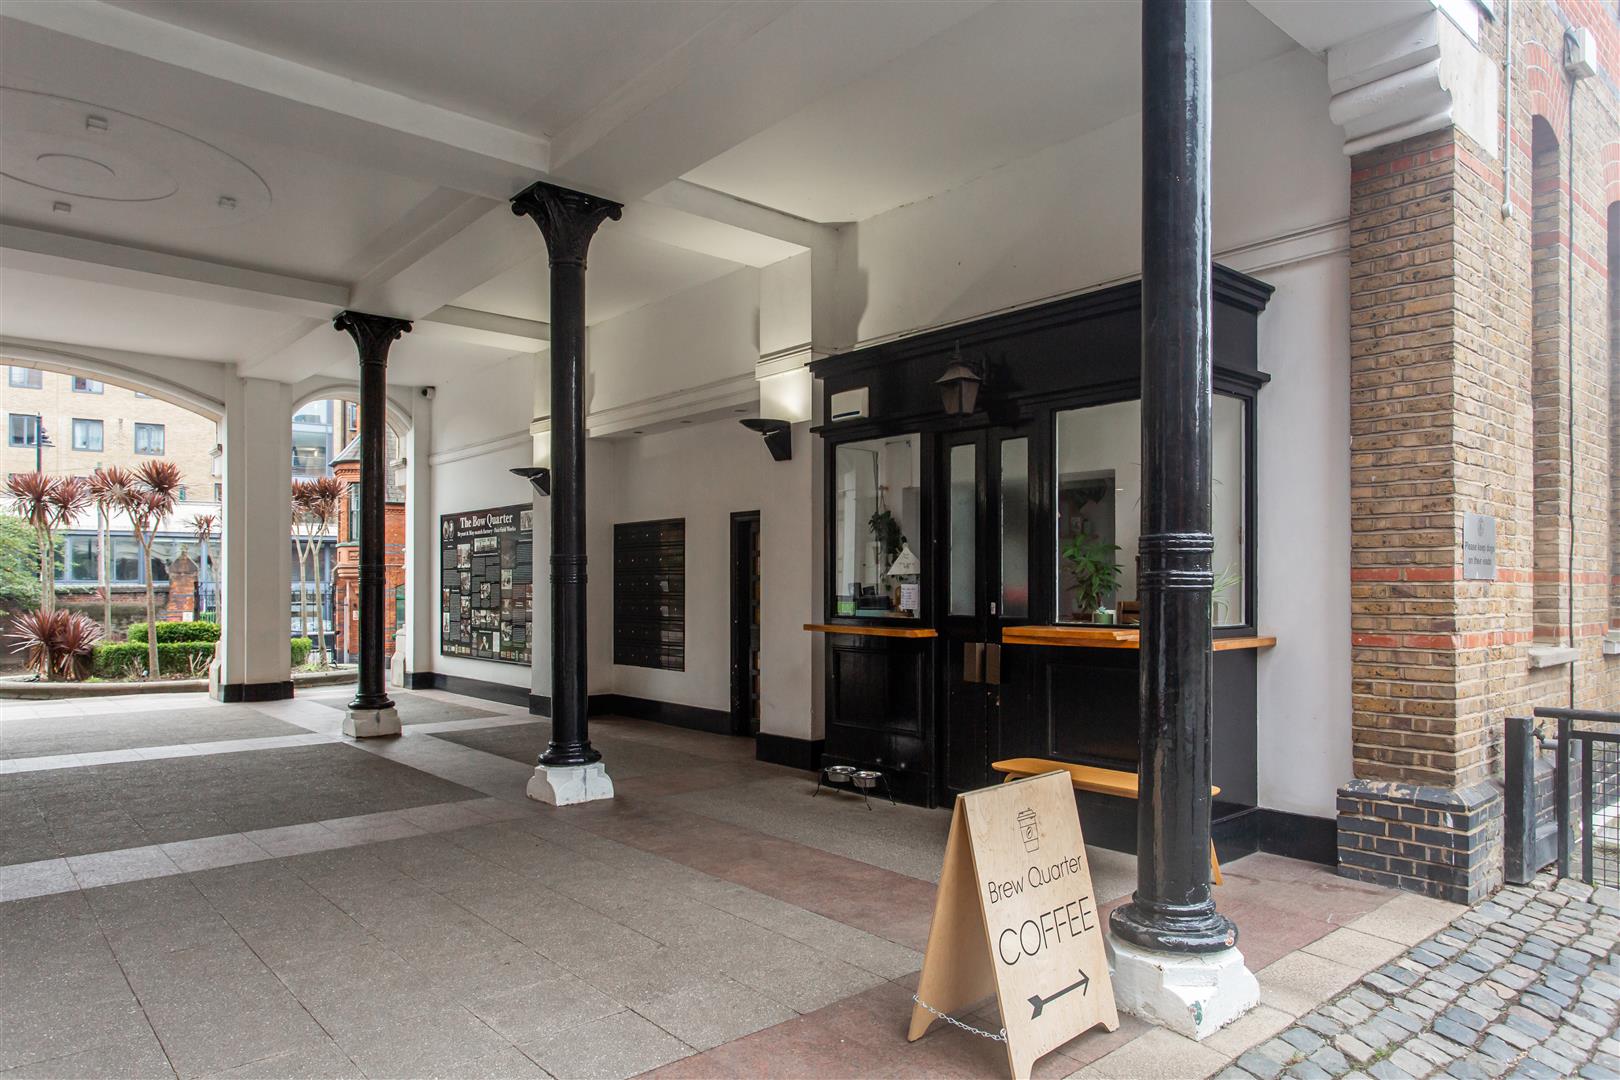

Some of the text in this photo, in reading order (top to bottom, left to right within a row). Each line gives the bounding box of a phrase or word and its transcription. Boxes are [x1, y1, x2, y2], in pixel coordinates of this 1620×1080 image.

[460, 513, 513, 528] The Bow Quarter
[988, 855, 1082, 904] Brew Quarter
[999, 896, 1095, 966] COFFEE
